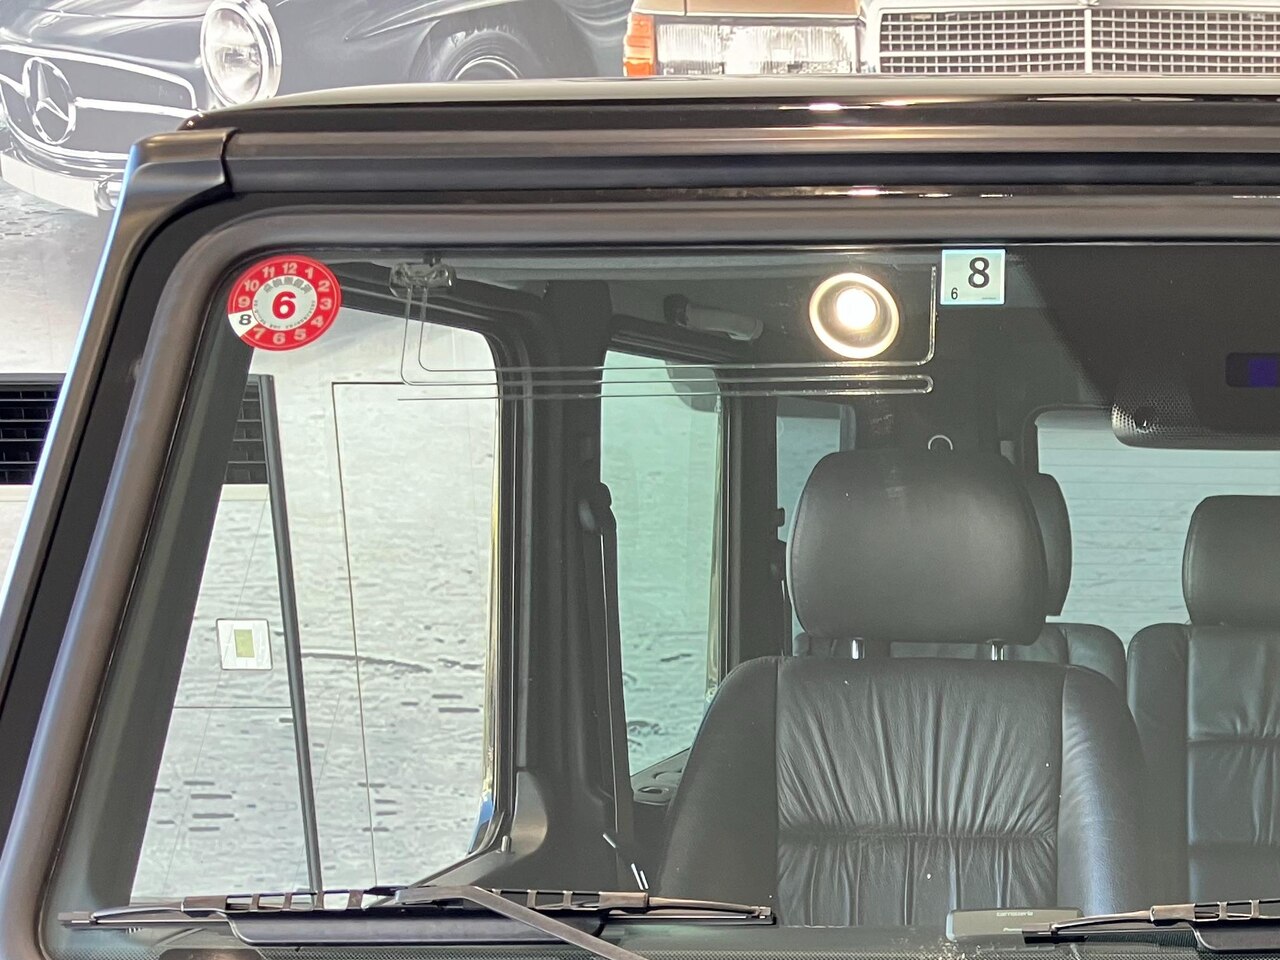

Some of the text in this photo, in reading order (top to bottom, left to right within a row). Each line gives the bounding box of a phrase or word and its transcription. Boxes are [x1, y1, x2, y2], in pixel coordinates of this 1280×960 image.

[262, 266, 276, 278] 11
[282, 262, 298, 275] 12
[305, 267, 314, 280] 1
[967, 256, 990, 289] 8
[244, 280, 260, 292] 10
[317, 280, 331, 293] 2
[951, 287, 959, 300] 6
[237, 295, 251, 308] 9
[272, 291, 297, 320] 6
[319, 298, 332, 311] 3
[239, 314, 252, 326] 8
[310, 315, 324, 328] 4
[253, 327, 266, 340] 7
[272, 332, 286, 345] 6
[293, 328, 307, 341] 5
